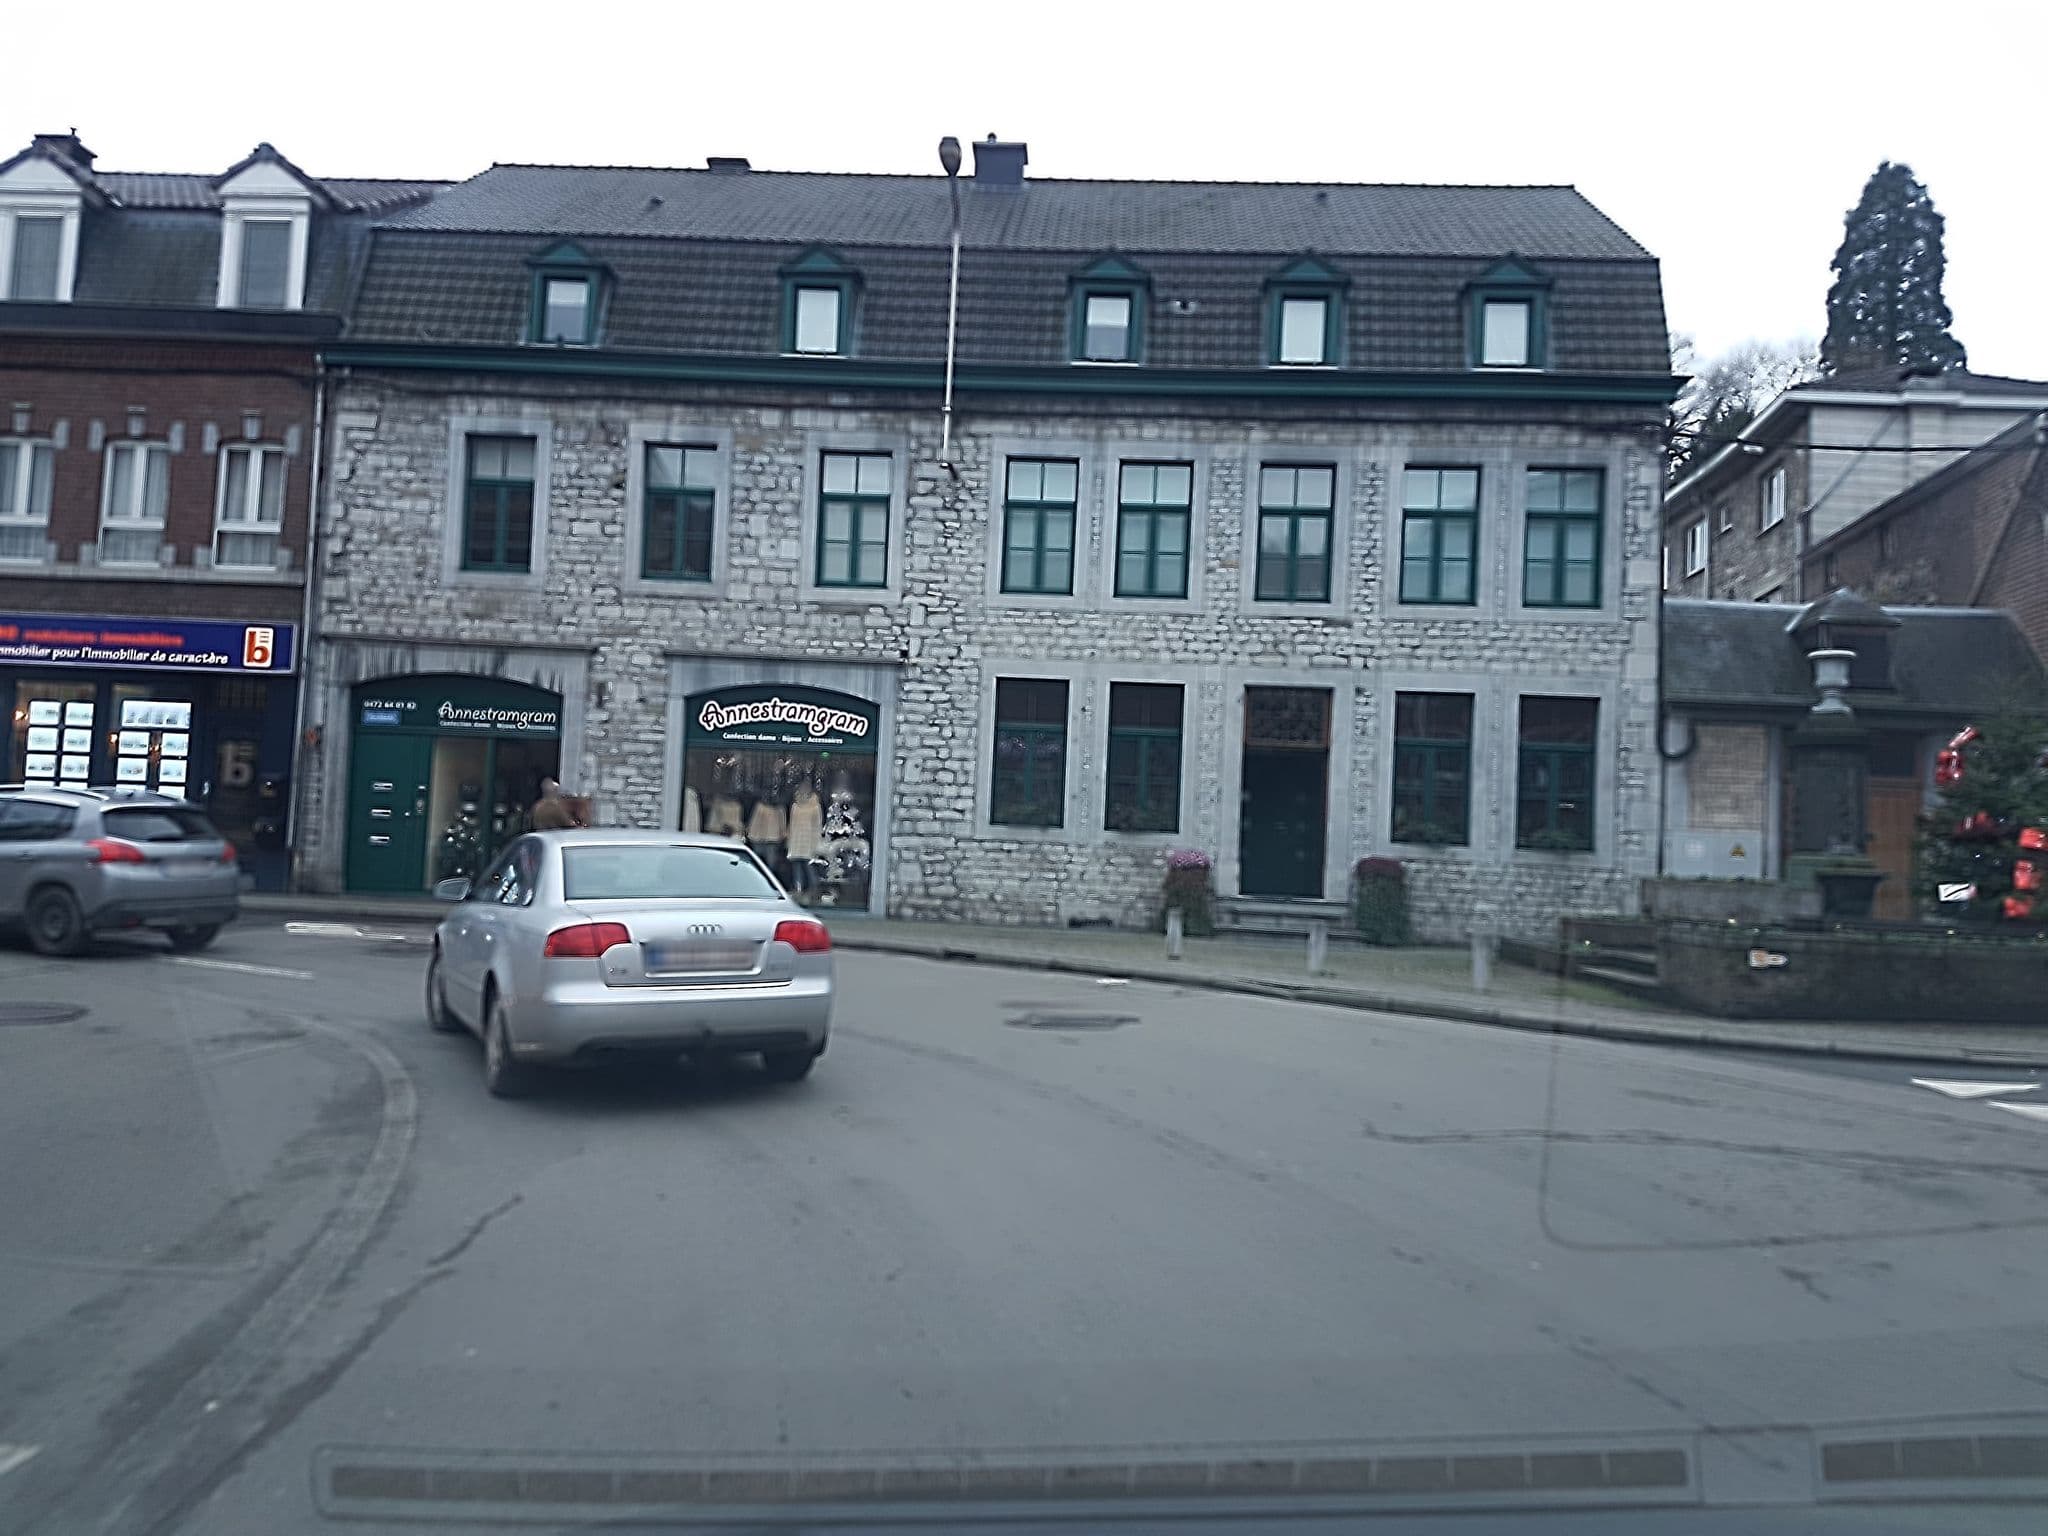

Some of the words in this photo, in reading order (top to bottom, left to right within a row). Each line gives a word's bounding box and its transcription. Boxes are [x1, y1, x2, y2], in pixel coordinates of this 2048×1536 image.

[52, 648, 80, 661] pour
[150, 650, 165, 662] de
[168, 652, 228, 665] caractère
[438, 701, 556, 729] Annestramgram
[700, 698, 868, 736] Annestramgram
[722, 732, 756, 741] Confection
